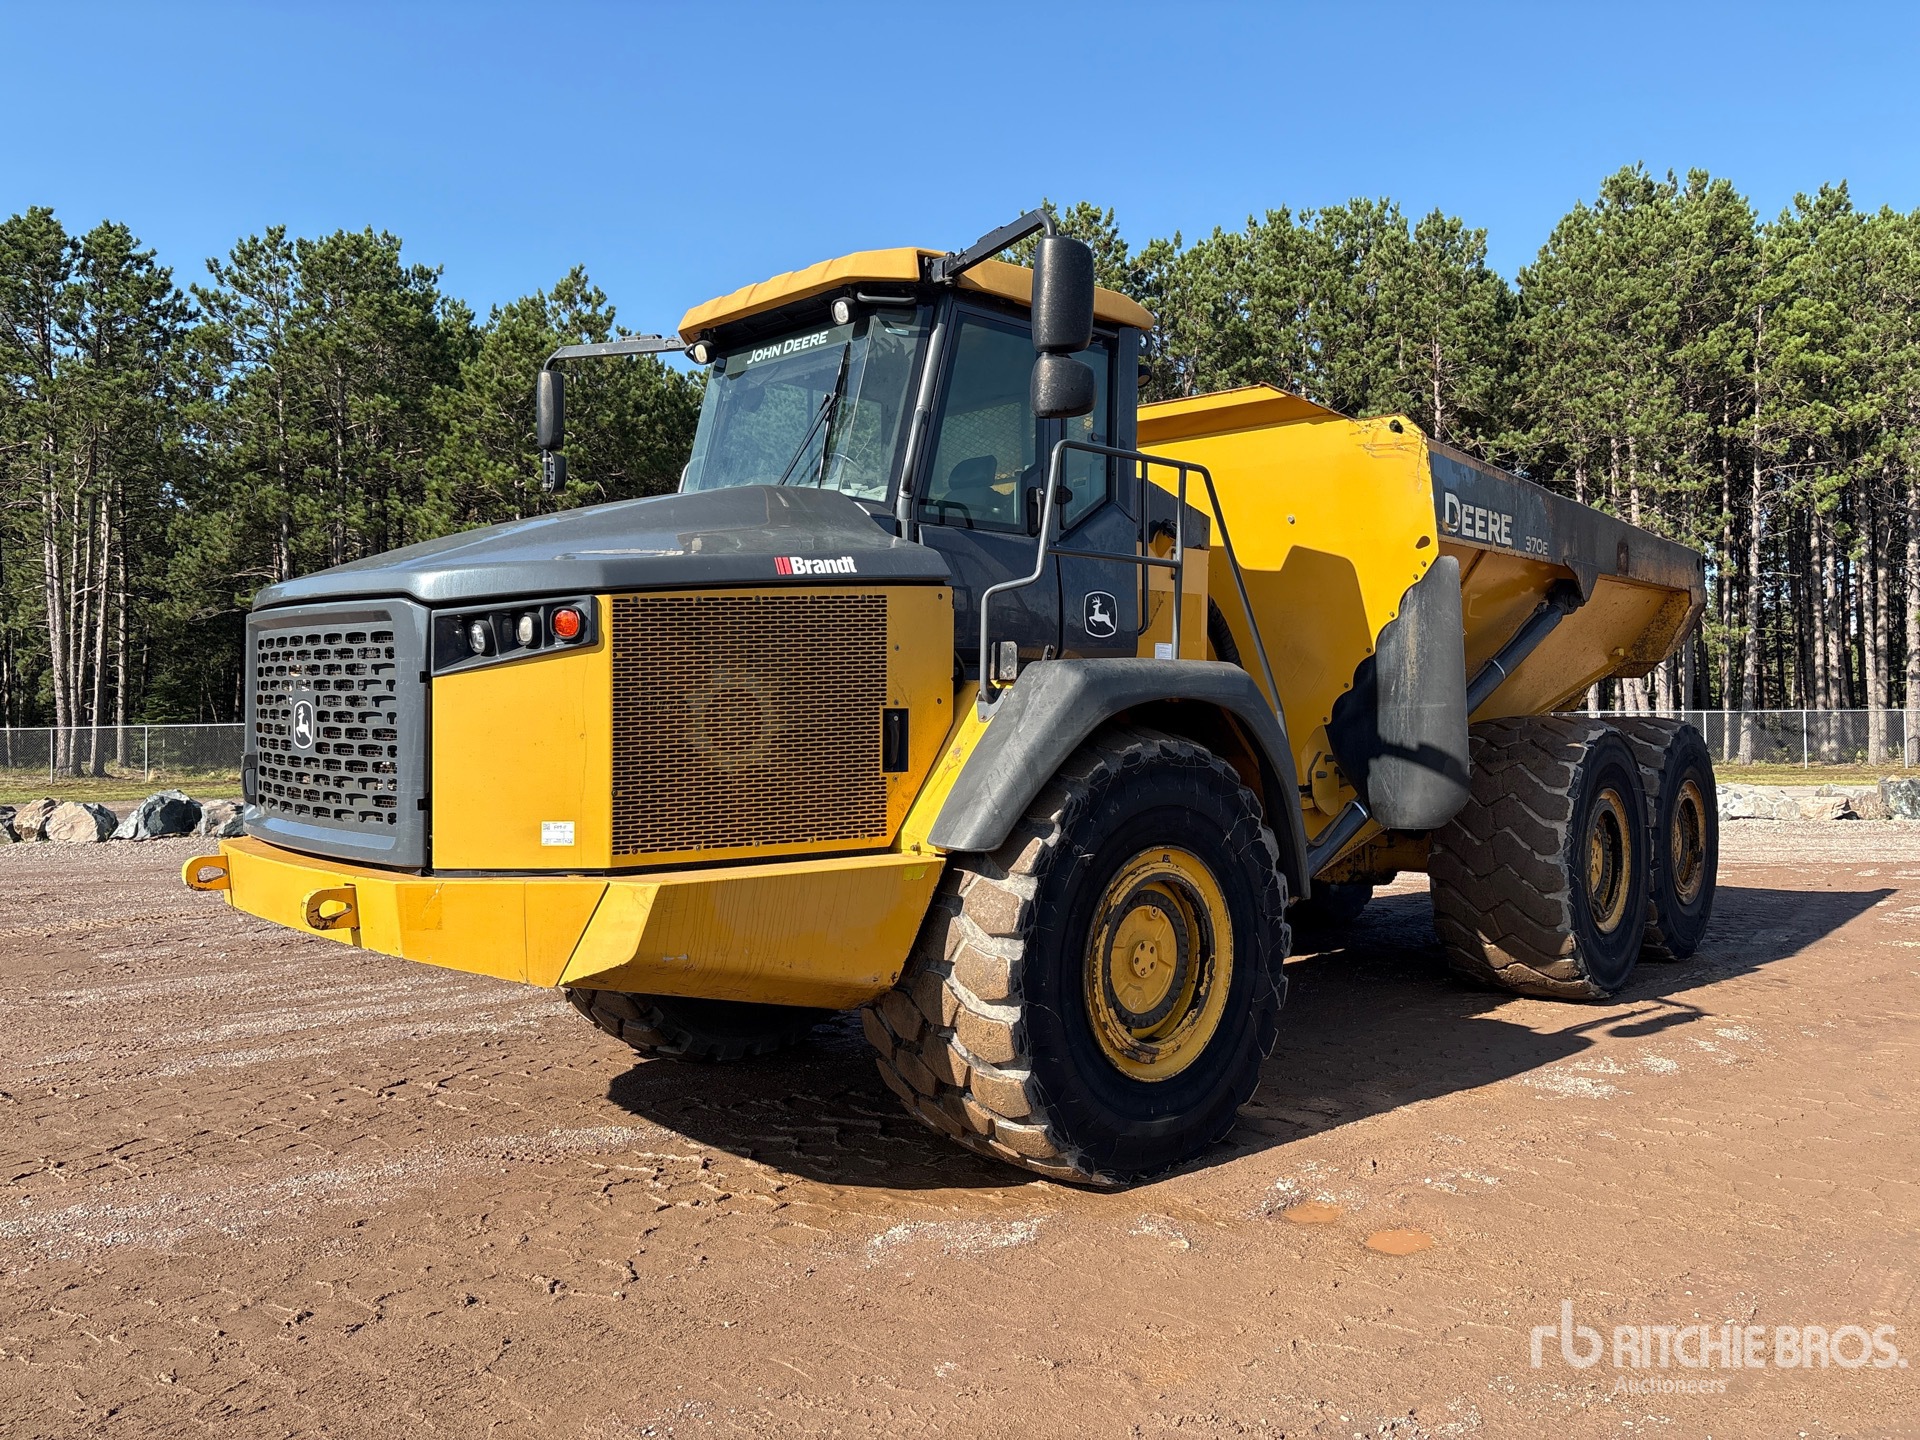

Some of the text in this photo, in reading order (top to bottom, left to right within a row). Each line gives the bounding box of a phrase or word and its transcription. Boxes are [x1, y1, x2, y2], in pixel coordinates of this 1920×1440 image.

[746, 331, 829, 364] JOHN DEERE
[1444, 491, 1513, 546] DEERE
[1525, 536, 1549, 555] 370E
[789, 556, 858, 575] Brandt
